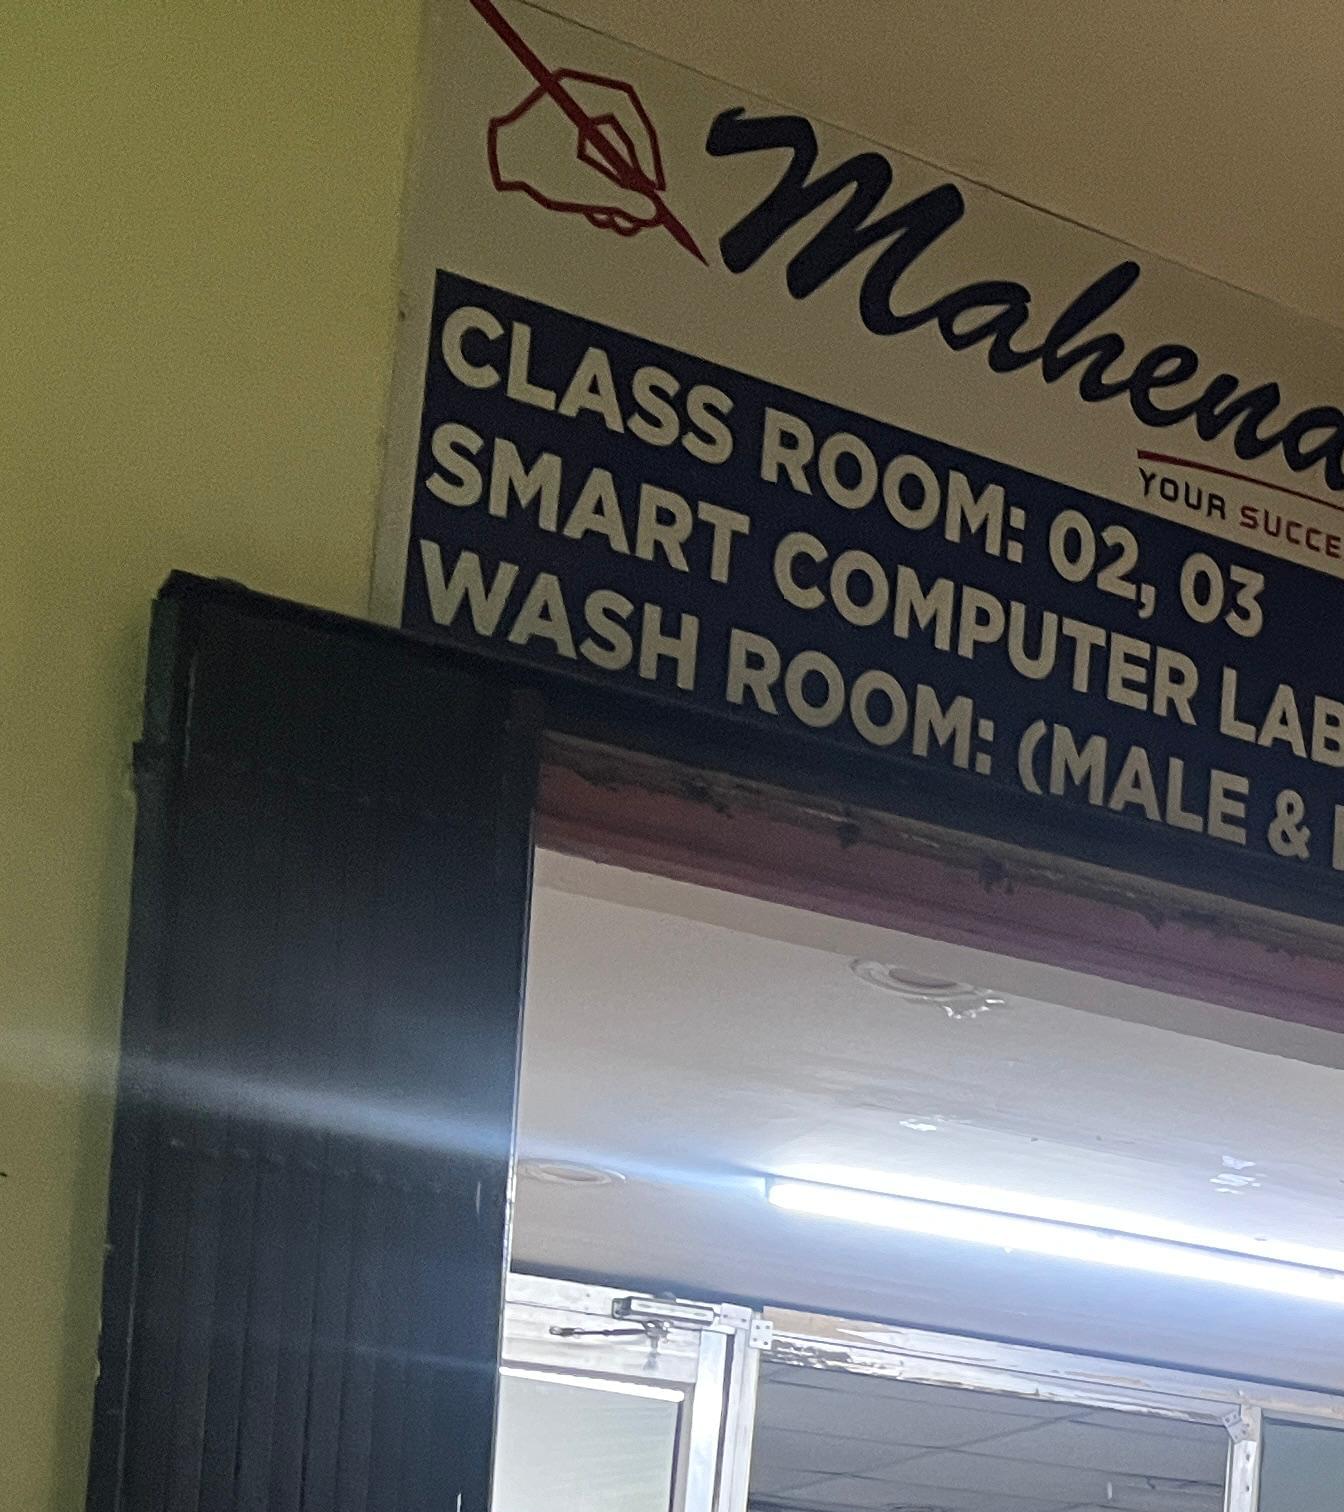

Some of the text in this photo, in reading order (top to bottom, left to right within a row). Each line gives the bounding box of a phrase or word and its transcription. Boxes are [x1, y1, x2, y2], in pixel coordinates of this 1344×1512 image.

[425, 423, 749, 582] SMART
[774, 532, 1197, 724] COMPUTER
[441, 306, 1264, 637] CLASS ROOM: 02, 03
[1138, 467, 1226, 518] YOUR
[420, 540, 699, 690] WASH
[726, 627, 993, 775] ROOM:
[1018, 719, 1250, 845] (MALE
[1268, 790, 1310, 859] &
